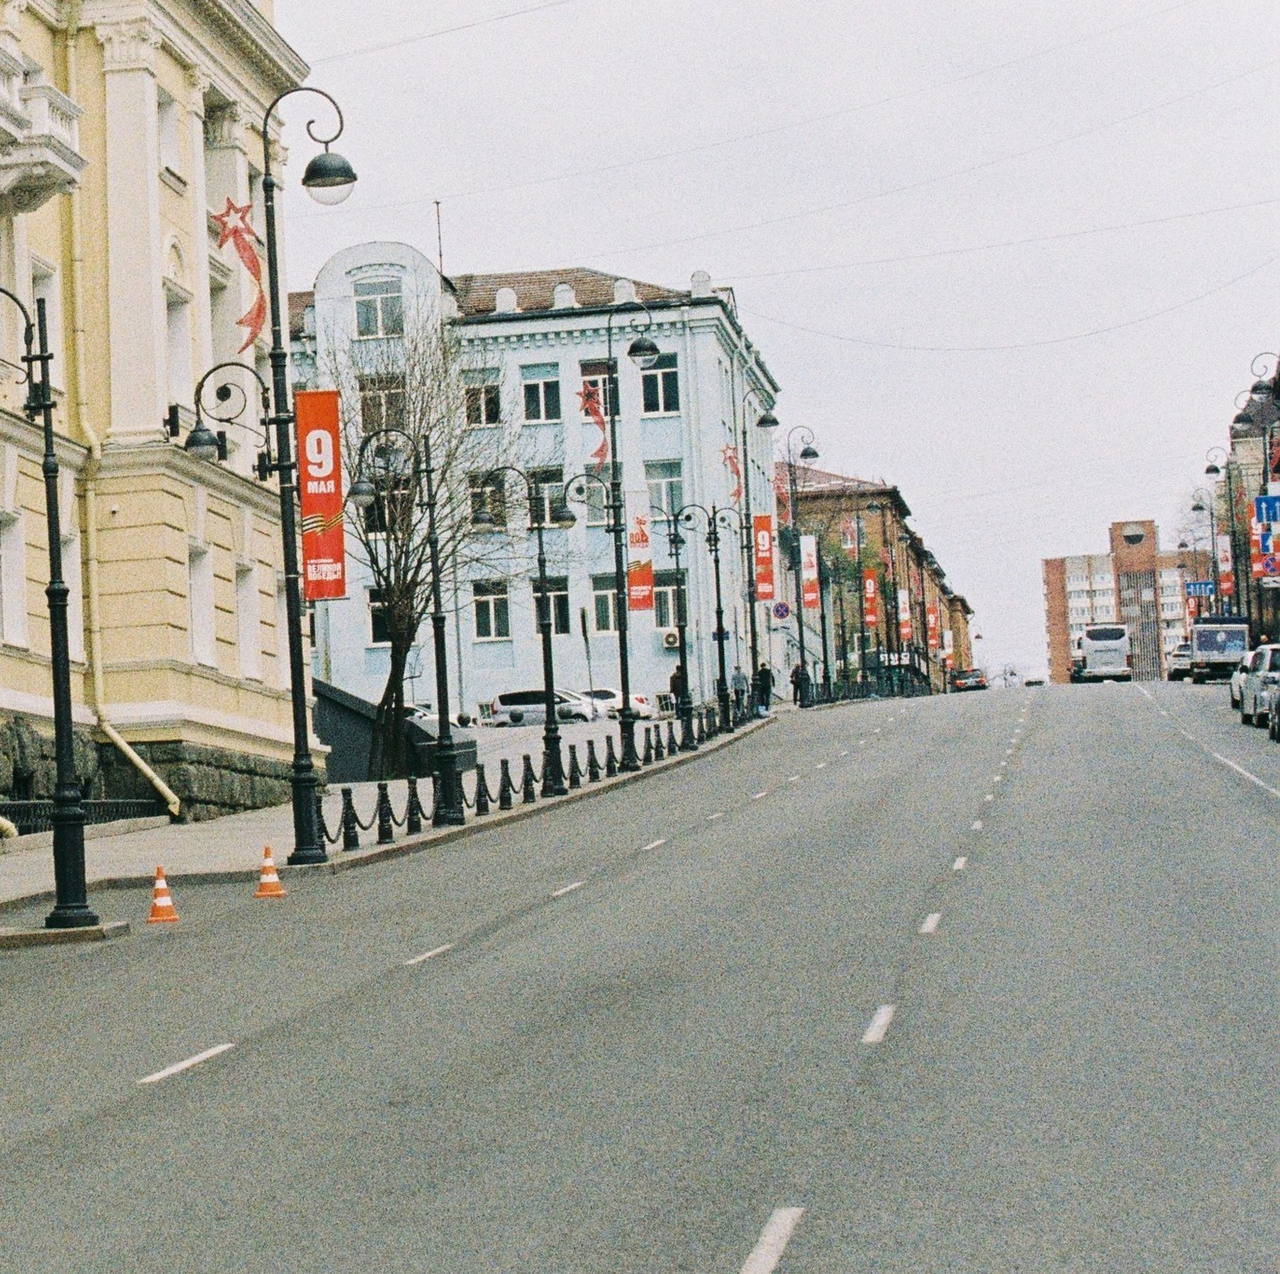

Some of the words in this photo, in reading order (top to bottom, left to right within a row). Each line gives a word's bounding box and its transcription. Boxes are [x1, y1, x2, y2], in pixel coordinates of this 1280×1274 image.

[306, 429, 334, 478] 9
[307, 480, 335, 494] МАЯ
[757, 530, 770, 551] 9
